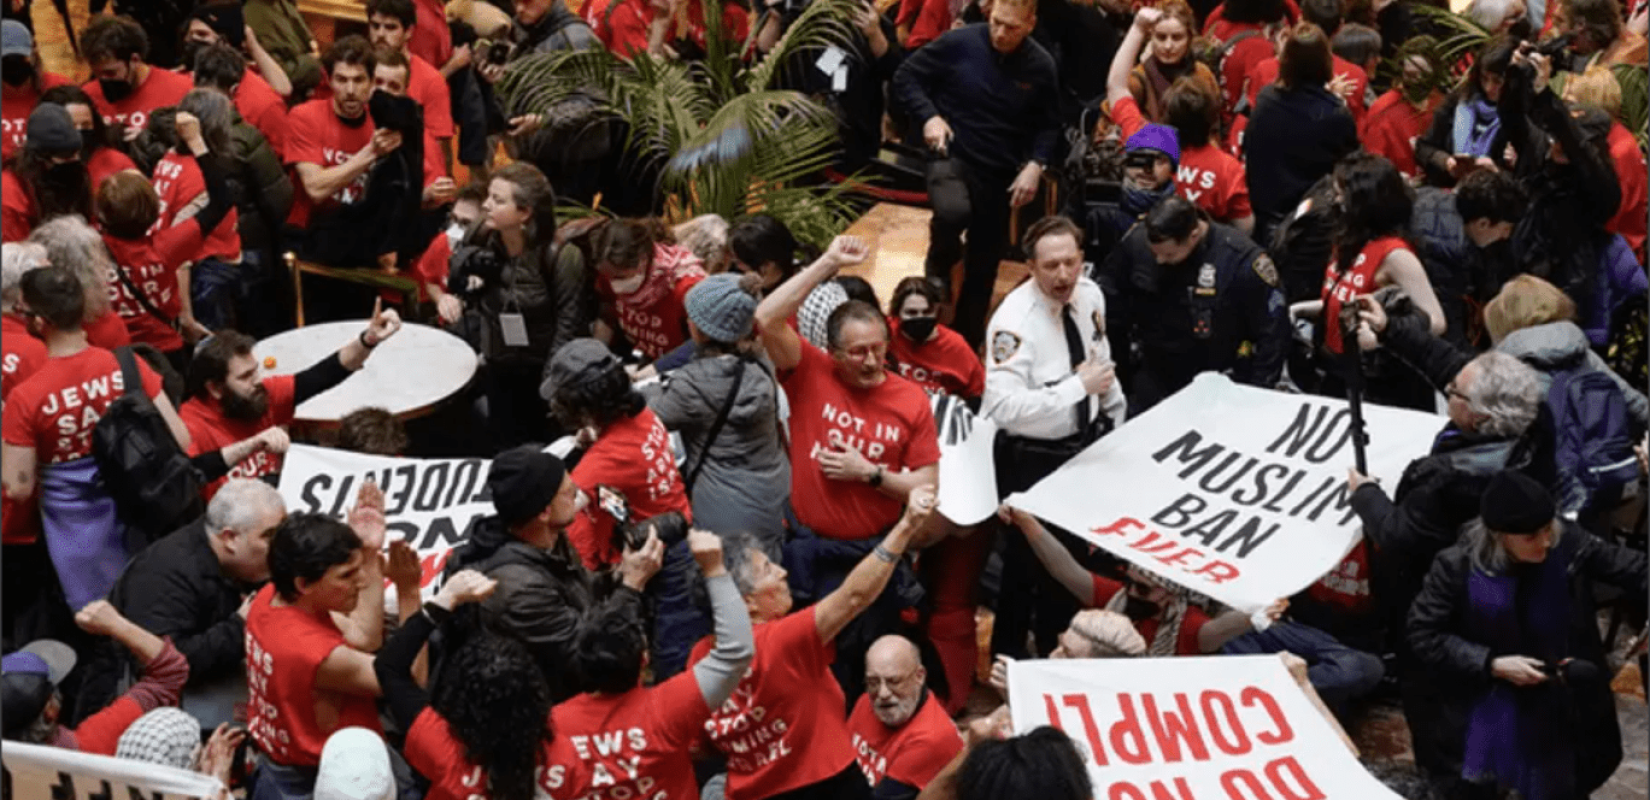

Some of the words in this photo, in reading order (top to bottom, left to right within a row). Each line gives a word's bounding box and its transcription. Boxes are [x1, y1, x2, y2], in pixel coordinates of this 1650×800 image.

[42, 370, 125, 415] JEWS
[821, 402, 866, 433] NOT
[875, 422, 900, 443] IN
[1265, 402, 1352, 463] NO
[1151, 429, 1357, 526] MUSLIM
[1149, 492, 1282, 559] BAN
[591, 755, 642, 787] AY
